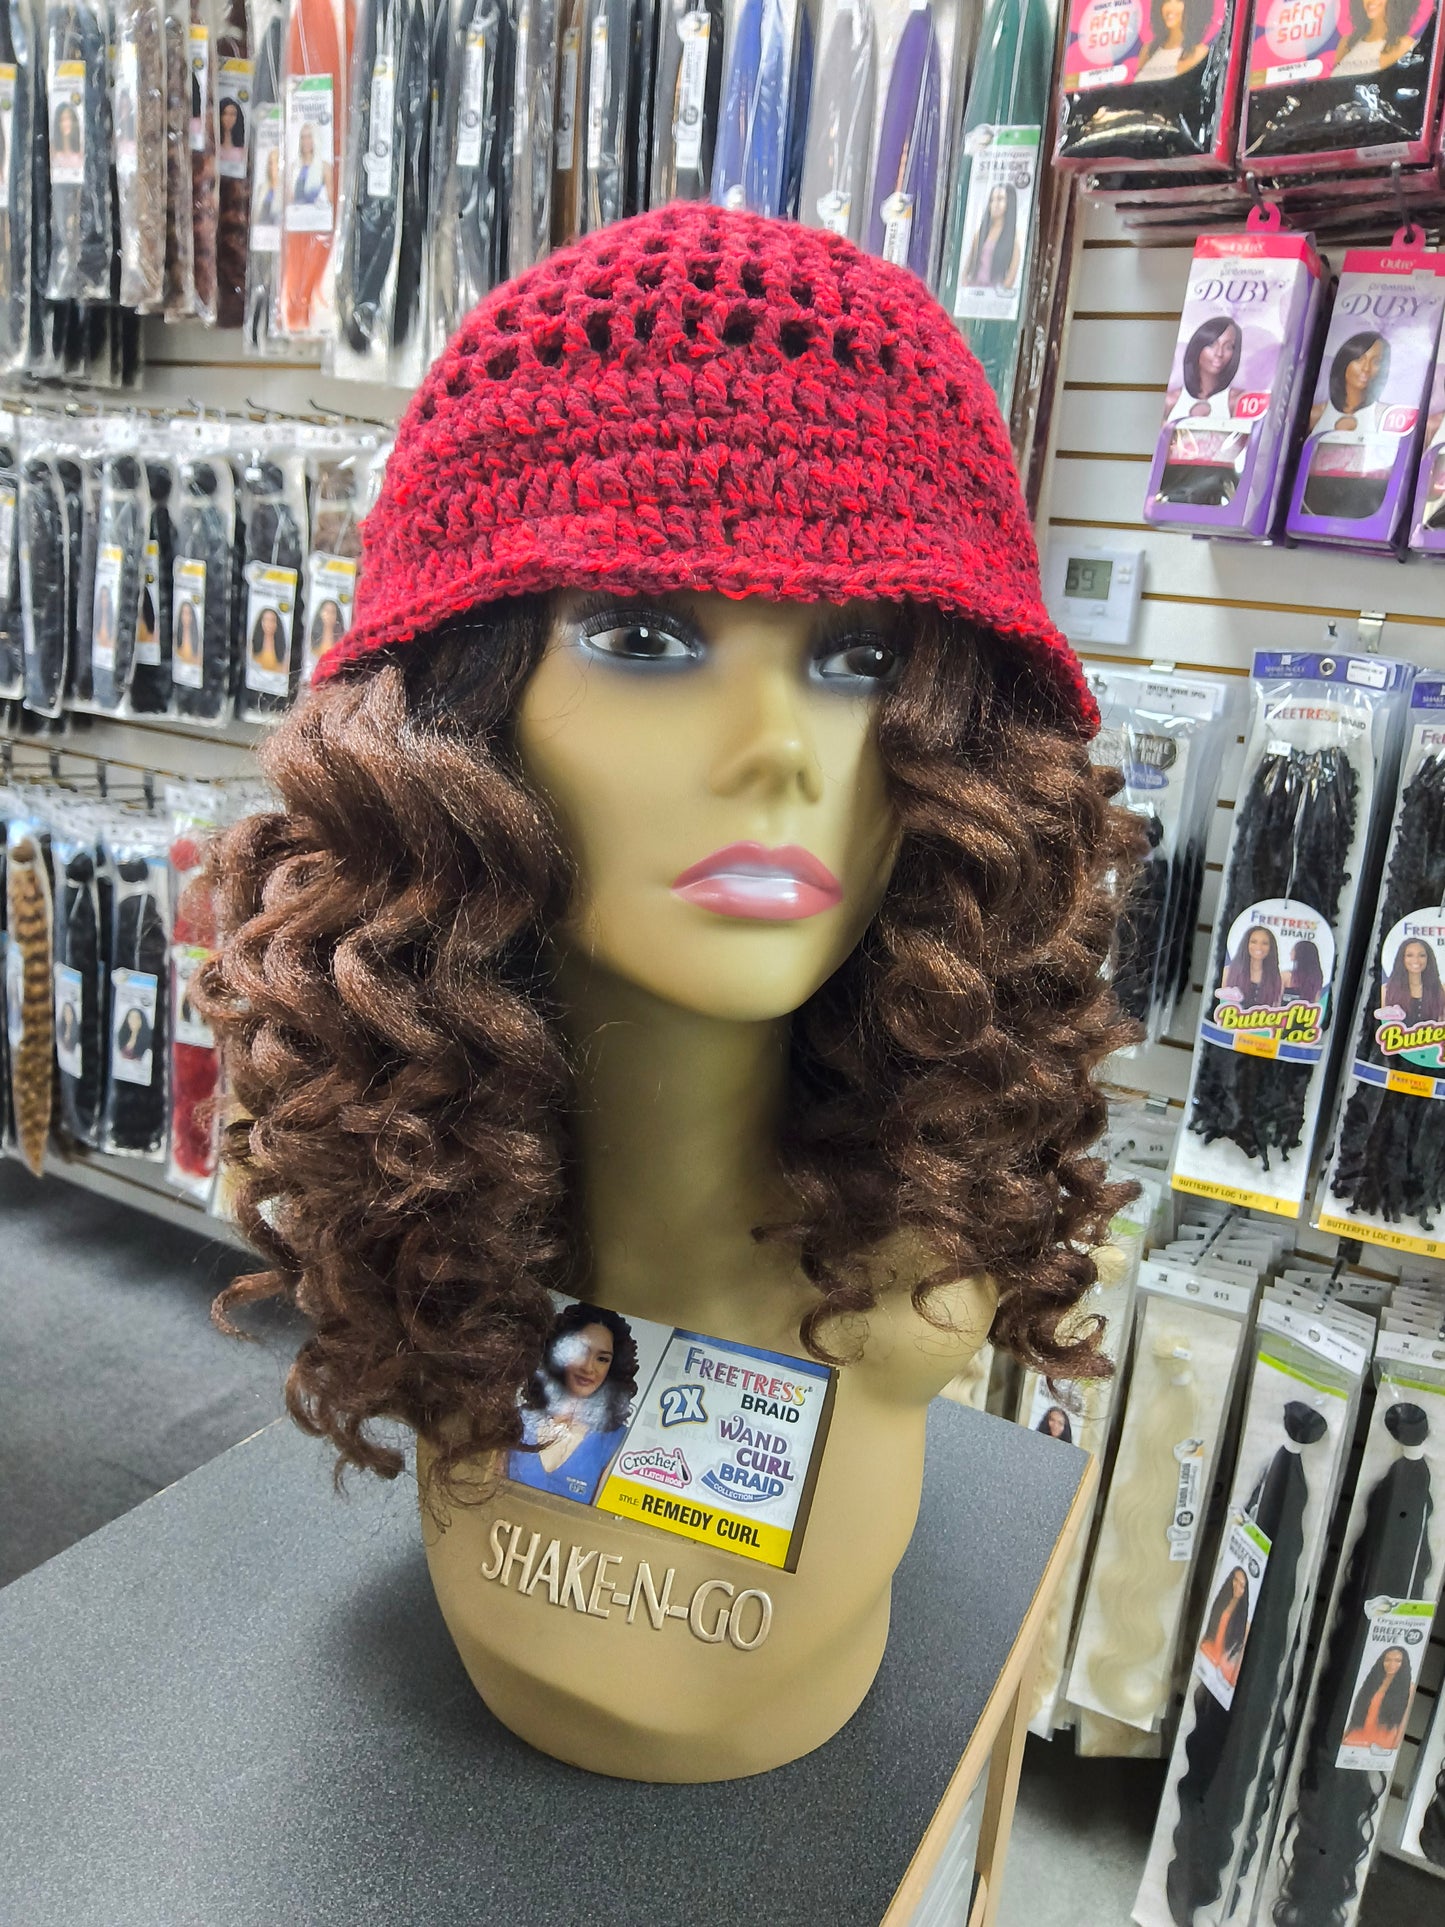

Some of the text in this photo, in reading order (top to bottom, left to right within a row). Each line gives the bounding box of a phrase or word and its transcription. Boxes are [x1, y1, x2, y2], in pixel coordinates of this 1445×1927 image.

[1194, 279, 1286, 303] DUBY
[1341, 293, 1437, 318] DUBY
[1250, 909, 1318, 931] FREETRESS
[1403, 922, 1445, 937] FREET
[1280, 928, 1316, 941] BRAID
[1218, 1004, 1319, 1030] Butterfly
[1381, 1025, 1445, 1051] Butte
[1178, 1179, 1219, 1193] BUTTERFLY
[1221, 1189, 1236, 1199] LOC
[1326, 1219, 1371, 1236] BUTTERFLY
[1372, 1231, 1388, 1241] LOC
[661, 1386, 707, 1426] 2X
[740, 1394, 800, 1424] BRAID
[720, 1415, 788, 1455] WAND
[623, 1451, 676, 1471] Crochet
[736, 1447, 794, 1481] CURL
[712, 1482, 754, 1501] COLLECTION
[719, 1463, 784, 1496] BRAID
[641, 1493, 713, 1531] REMEDY
[716, 1518, 760, 1548] CURL
[481, 1519, 773, 1651] SHAKE-N-GO
[1371, 1634, 1397, 1643] WAVE
[1373, 1626, 1409, 1636] BREEZY
